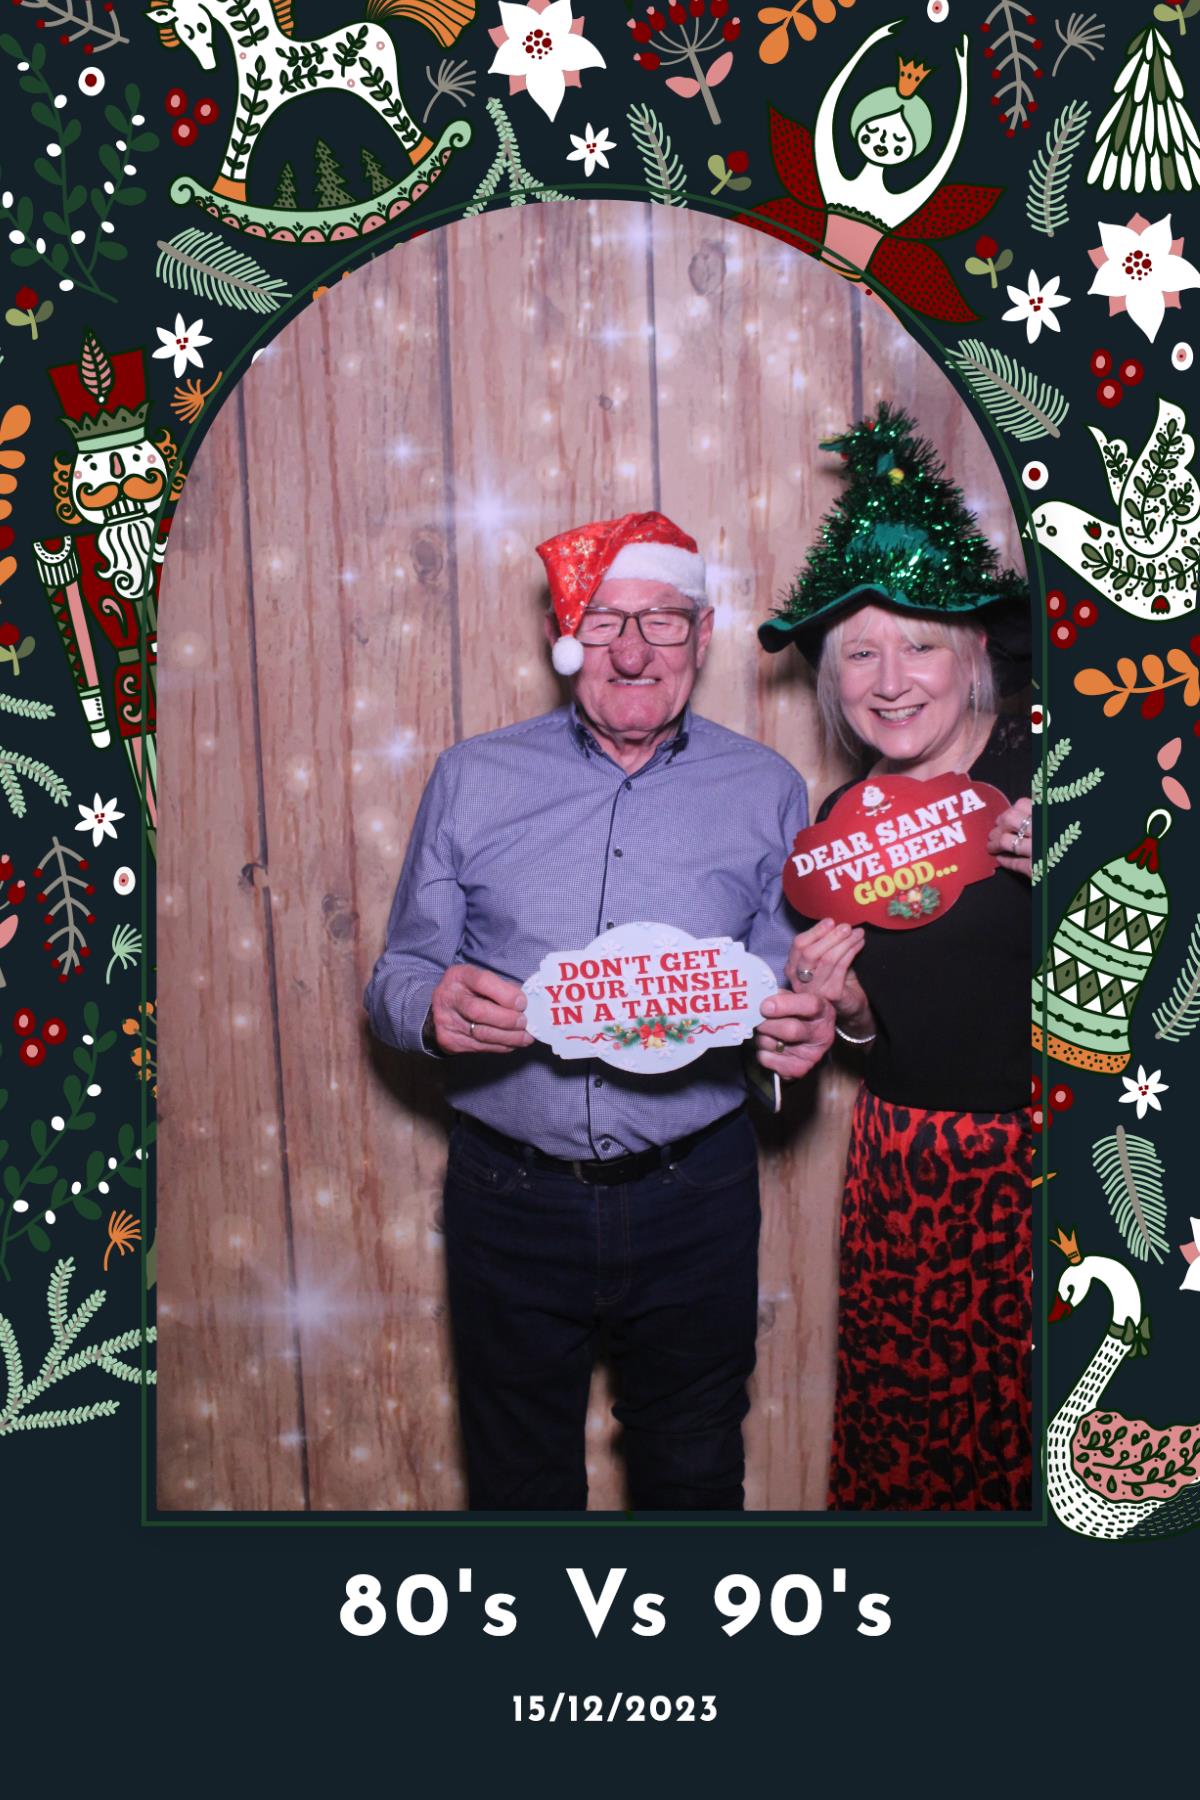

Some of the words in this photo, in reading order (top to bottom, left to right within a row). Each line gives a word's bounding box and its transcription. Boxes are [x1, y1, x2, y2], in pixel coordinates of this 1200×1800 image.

[792, 831, 873, 877] DEAR
[875, 789, 986, 846] SANTA
[825, 852, 885, 891] I'VE
[885, 820, 967, 868] BEEN
[853, 861, 958, 905] GOOD...
[558, 955, 650, 981] DON'T
[660, 948, 720, 972] GET
[545, 980, 628, 1003] YOUR
[635, 969, 747, 996] TINSEL
[550, 1005, 583, 1026] IN
[594, 1003, 615, 1022] A
[622, 991, 748, 1018] TANGLE
